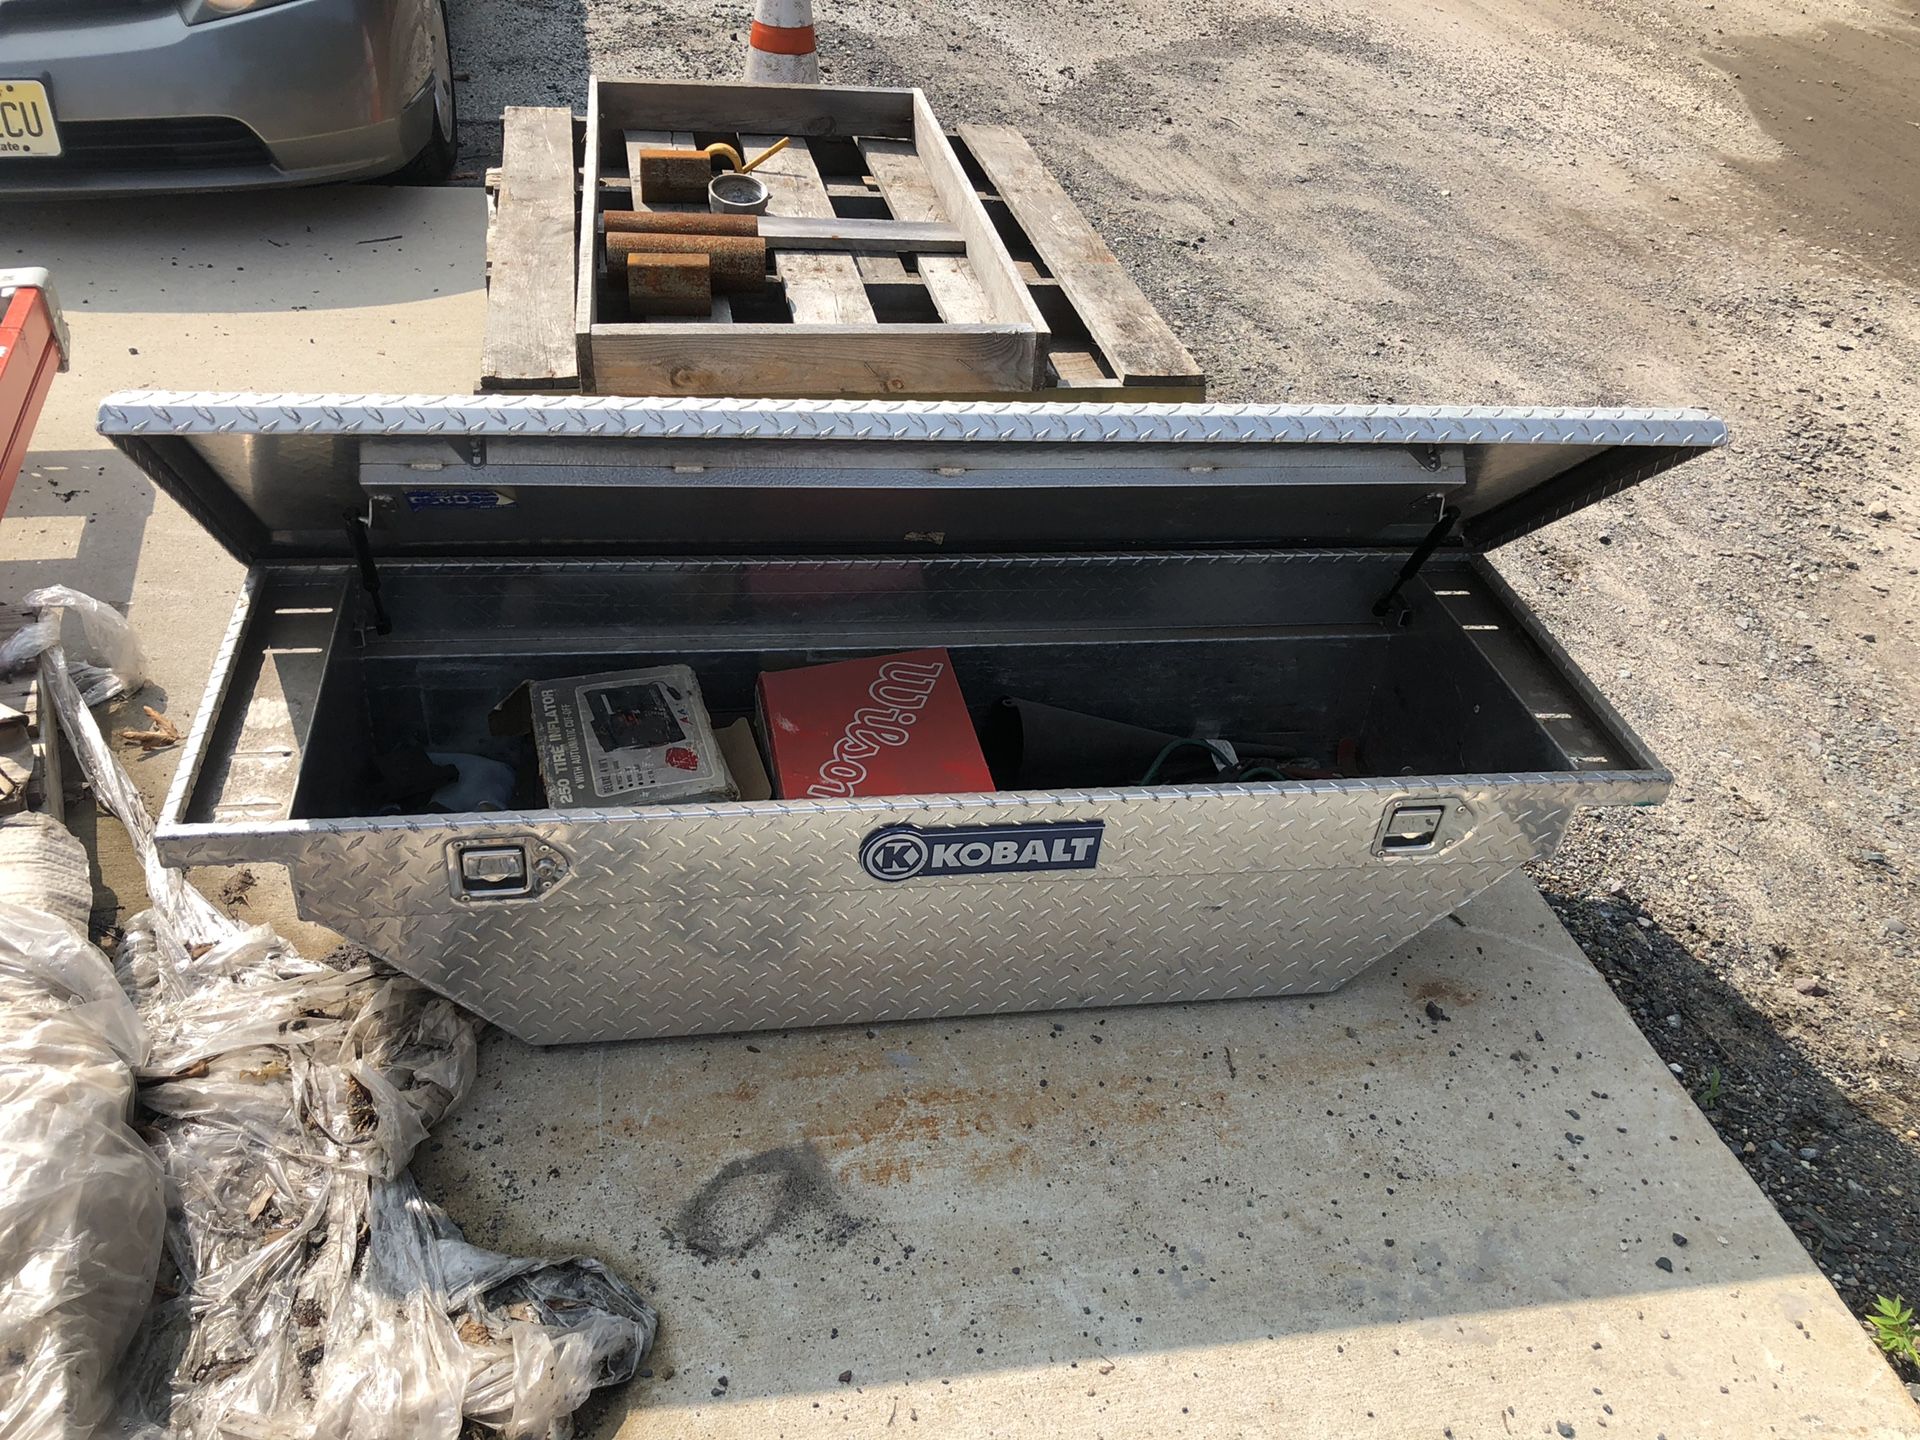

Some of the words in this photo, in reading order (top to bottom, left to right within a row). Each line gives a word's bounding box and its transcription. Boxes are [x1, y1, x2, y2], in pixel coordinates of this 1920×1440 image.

[0, 101, 44, 138] CU
[541, 689, 562, 742] INFLATOR
[550, 744, 568, 774] TIRE
[573, 766, 585, 784] WITH
[557, 778, 574, 804] 250
[931, 837, 1095, 869] KOBALT
